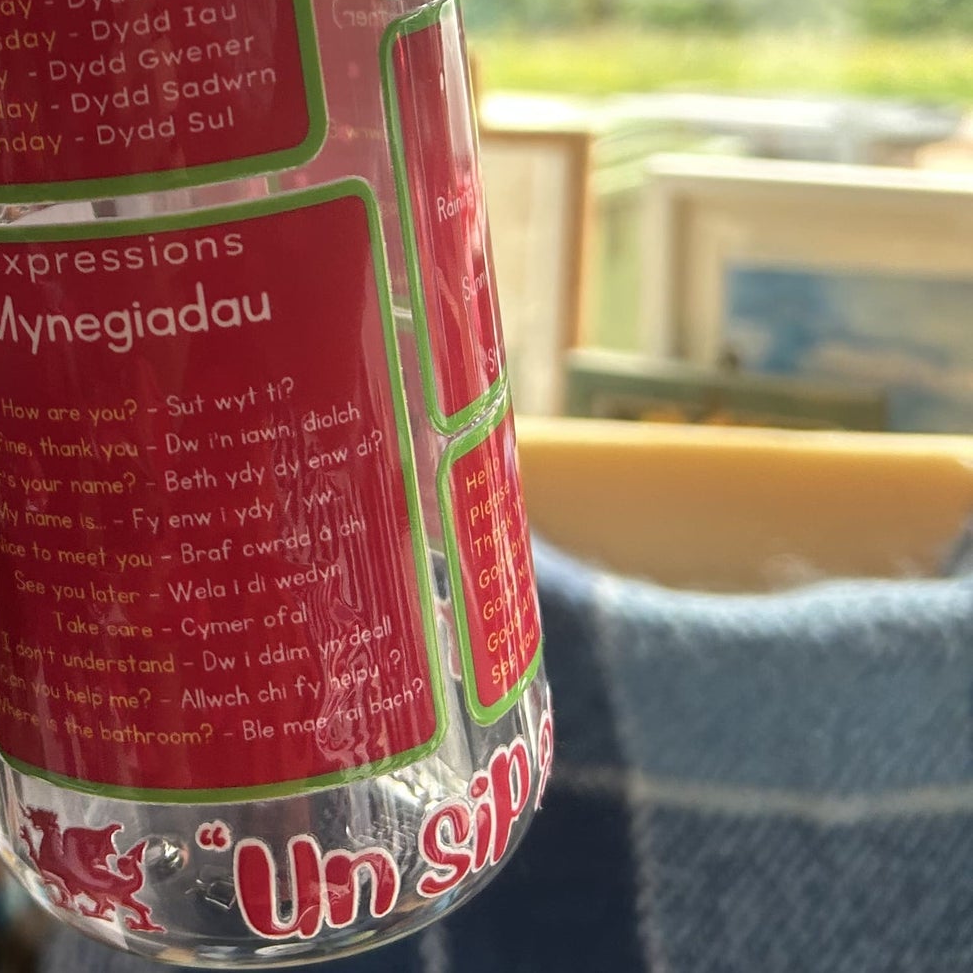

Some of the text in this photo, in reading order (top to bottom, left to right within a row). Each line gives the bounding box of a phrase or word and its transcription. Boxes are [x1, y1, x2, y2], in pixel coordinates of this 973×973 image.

[91, 11, 170, 43] Dydd
[184, 4, 237, 26] Iau
[49, 52, 126, 84] Dydd
[138, 35, 254, 70] Gwener
[71, 84, 150, 117] Dydd
[163, 65, 276, 101] Sadwrn
[97, 115, 175, 147] Dydd
[189, 106, 233, 133] Sul
[2, 398, 39, 420] How
[48, 407, 80, 421] are
[88, 399, 137, 426] you?
[166, 395, 205, 416] Sut
[215, 386, 258, 412] wyt
[40, 437, 93, 457] thank
[100, 442, 138, 462] you
[166, 433, 199, 454] Dw
[209, 433, 233, 449] i'n
[304, 401, 361, 432] diolch
[21, 478, 63, 495] your
[71, 472, 136, 494] name?
[165, 467, 217, 492] Beth
[225, 462, 265, 489] ydy
[274, 456, 300, 478] dy
[308, 448, 348, 469] enw
[357, 430, 383, 457] di?
[26, 507, 72, 528] name
[132, 508, 159, 534] Fy
[169, 510, 212, 528] enw
[220, 507, 226, 522] i
[235, 497, 274, 526] ydy
[32, 542, 52, 561] to
[58, 547, 107, 565] meet
[116, 554, 153, 572] you
[180, 539, 232, 564] Braf
[243, 530, 311, 557] cwrdd
[14, 562, 341, 604] See you later Wela i di wedyn
[52, 602, 308, 640] Take care Cymer ofal
[63, 653, 175, 673] understand
[203, 650, 235, 671] Dw
[245, 651, 250, 667] i
[259, 643, 309, 665] ddim
[349, 615, 393, 646] deall
[64, 682, 103, 708] help
[109, 688, 151, 709] me?
[181, 684, 249, 709] Allwch
[258, 681, 287, 703] chi
[295, 676, 321, 700] fy
[99, 721, 213, 745] bathroom?
[243, 719, 275, 741] Ble
[283, 717, 328, 735] mae
[369, 677, 423, 714] bach?
[416, 733, 528, 898] sip
